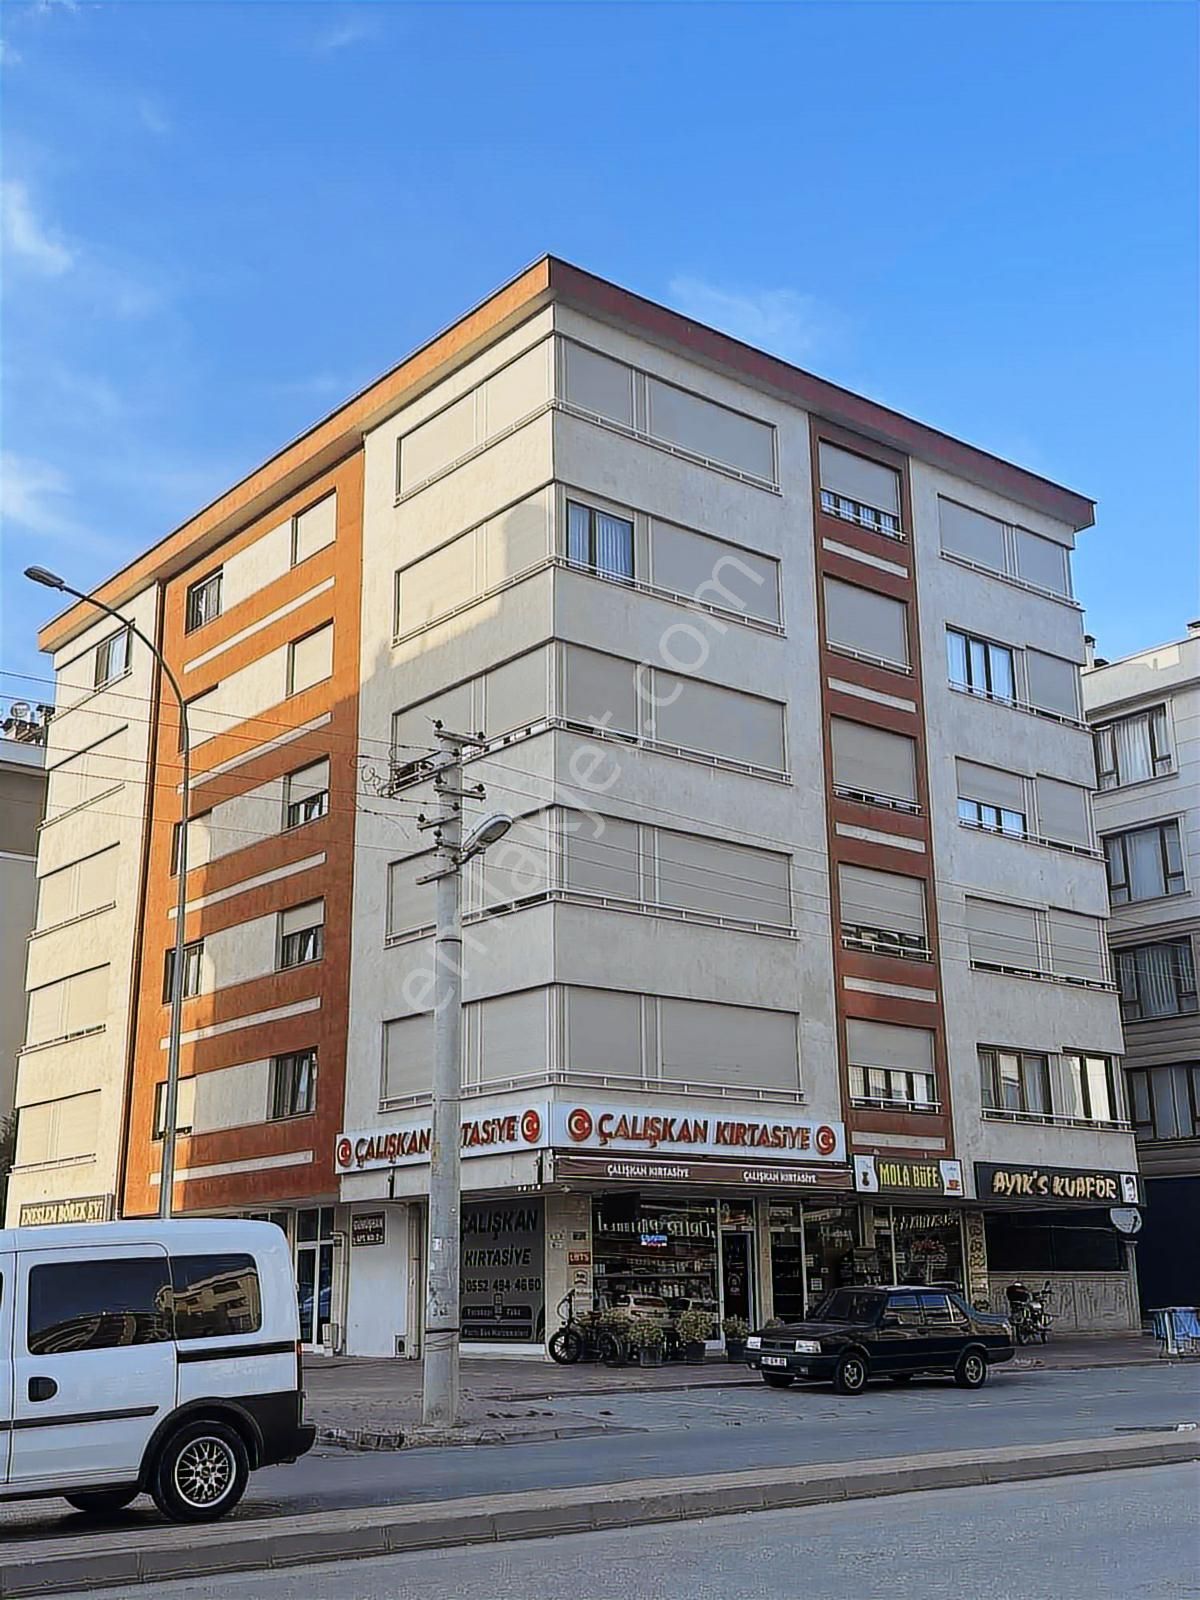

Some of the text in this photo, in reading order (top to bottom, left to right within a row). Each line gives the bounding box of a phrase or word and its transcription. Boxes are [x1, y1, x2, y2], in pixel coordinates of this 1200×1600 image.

[355, 1115, 519, 1168] ÇALIŞKAN TASİYE
[598, 1113, 811, 1150] ÇALIŞKAN KIRTASİYE
[607, 1164, 689, 1178] ÇALIŞKAN KIRTASİYE
[743, 1170, 817, 1184] ÇALIŞKAN KIRTASİYE
[879, 1163, 910, 1186] MOLA
[913, 1165, 939, 1188] BÜFE
[993, 1170, 1117, 1199] AYIK'S KUAFÖR
[465, 1244, 531, 1267] KIRTASİYE
[466, 1278, 489, 1293] 0552
